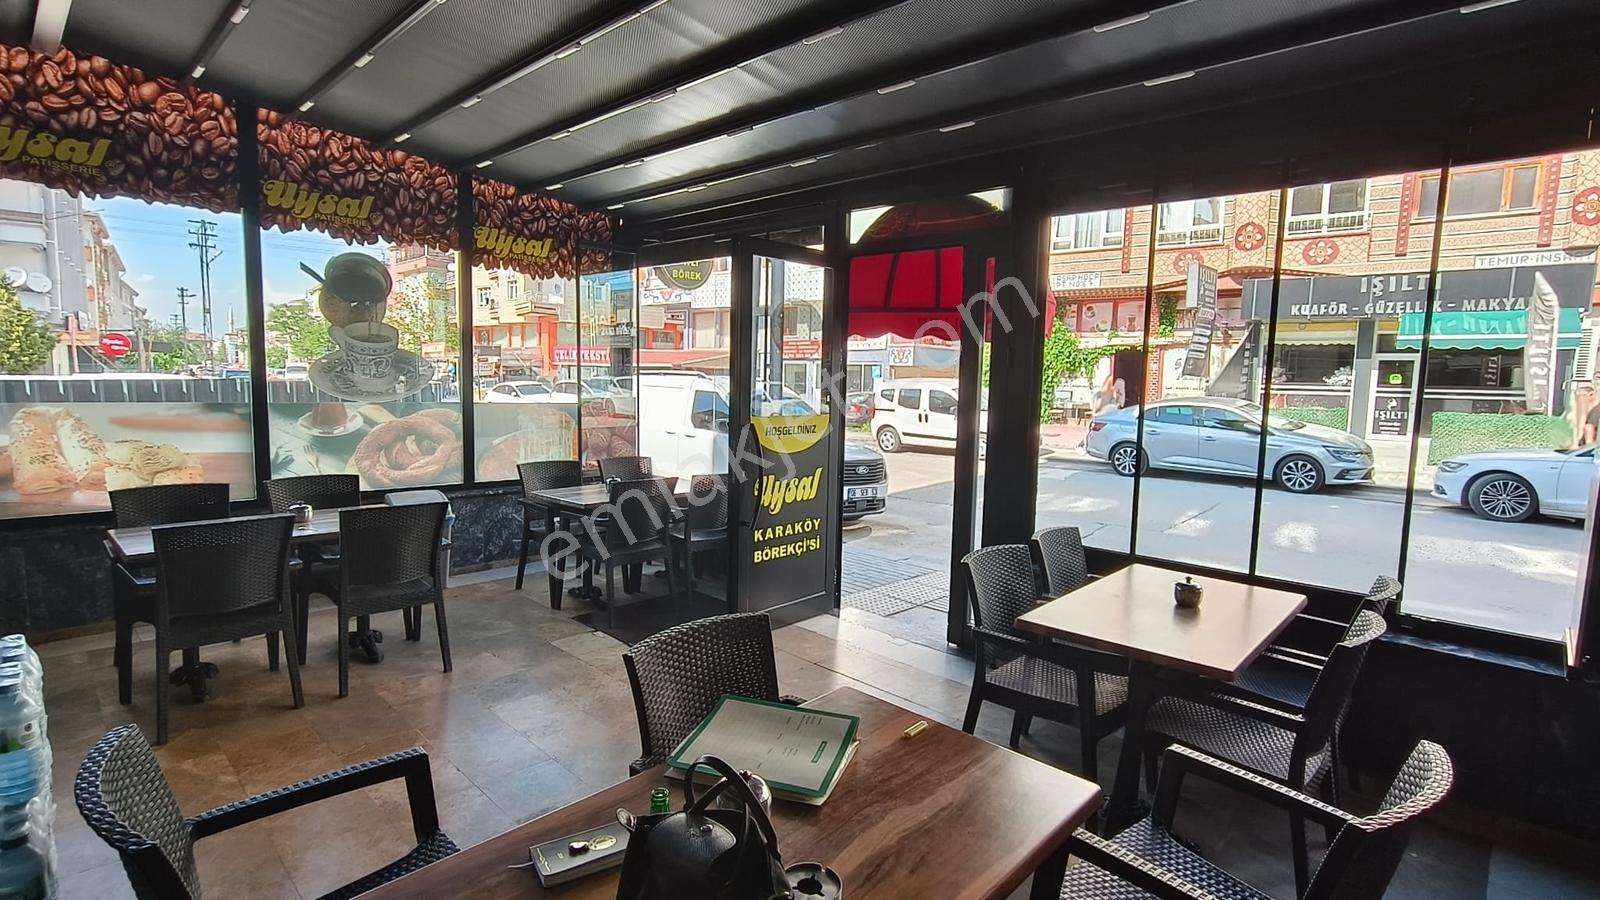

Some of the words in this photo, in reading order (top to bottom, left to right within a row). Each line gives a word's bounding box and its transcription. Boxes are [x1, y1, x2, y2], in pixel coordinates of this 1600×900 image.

[263, 179, 375, 219] Uysal
[474, 226, 554, 258] Uysal
[672, 268, 702, 281] BÖREK
[1360, 273, 1442, 297] IŞILTI
[1462, 297, 1526, 311] MAKYA
[1375, 410, 1408, 421] IŞILTI
[753, 467, 824, 515] Uysal
[753, 518, 821, 543] KARAKÖY
